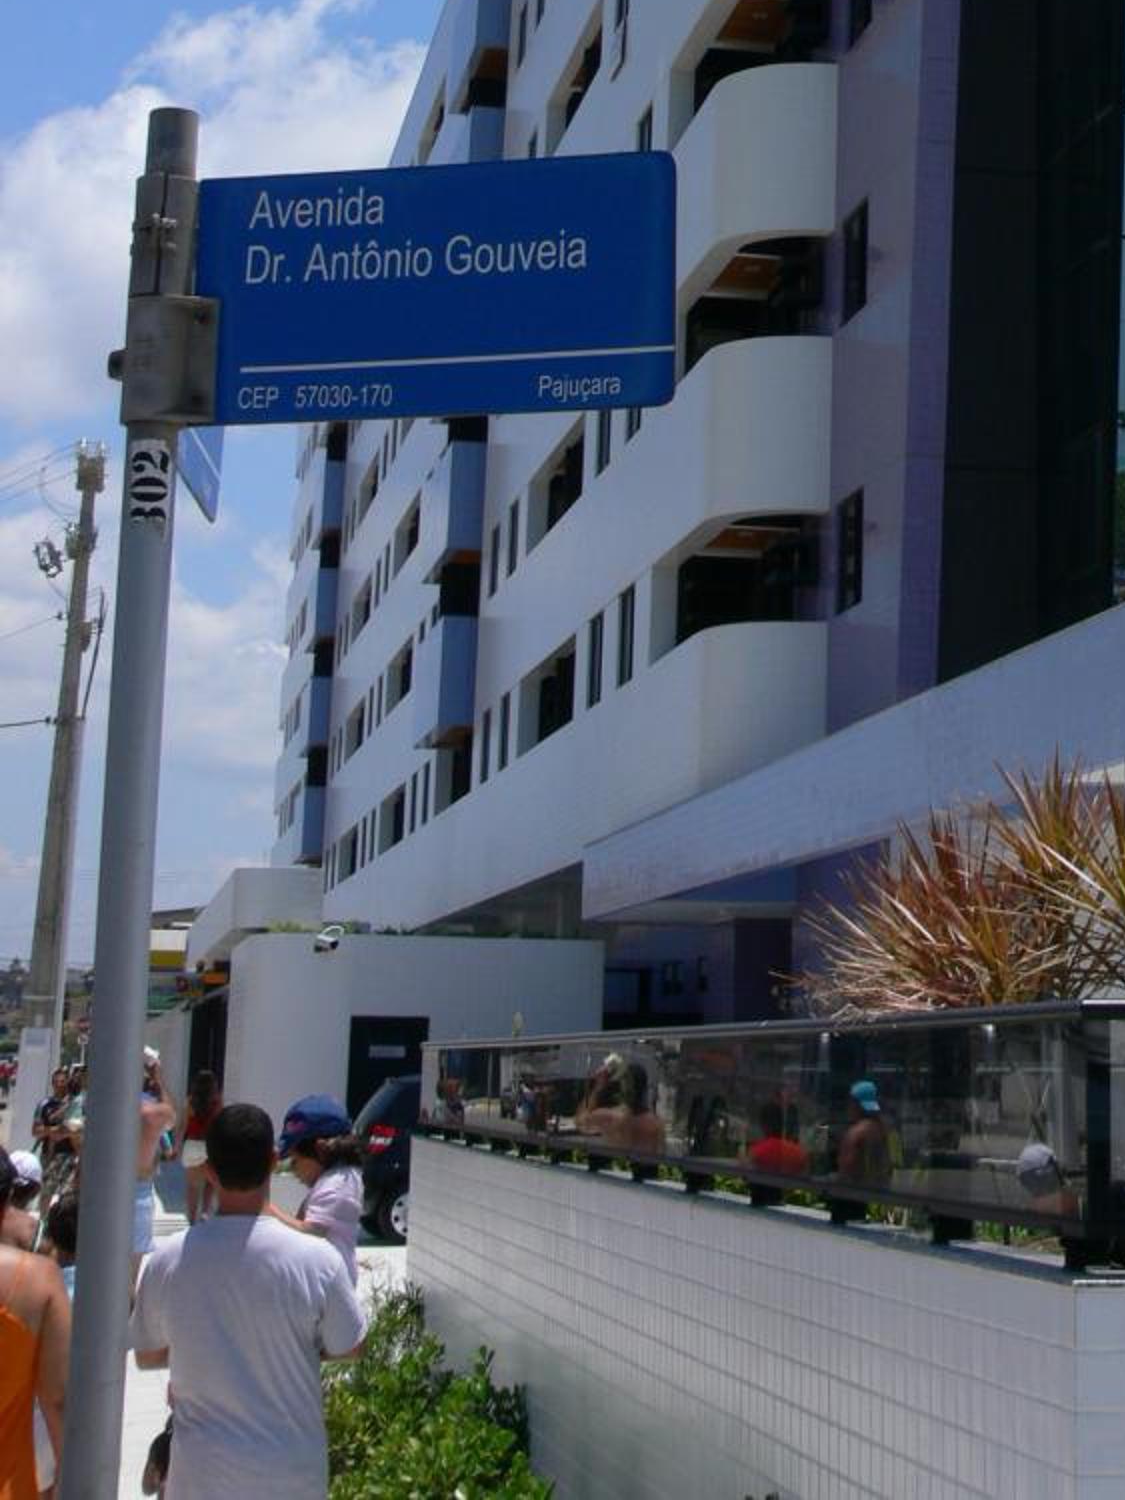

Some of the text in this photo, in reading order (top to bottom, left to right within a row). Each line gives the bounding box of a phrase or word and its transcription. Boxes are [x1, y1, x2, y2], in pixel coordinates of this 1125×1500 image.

[248, 185, 384, 229] Avenida
[245, 228, 588, 284] Dr. Antônio Gouveia
[238, 384, 393, 409] CEP 57030-170
[537, 374, 621, 403] Pajuçara
